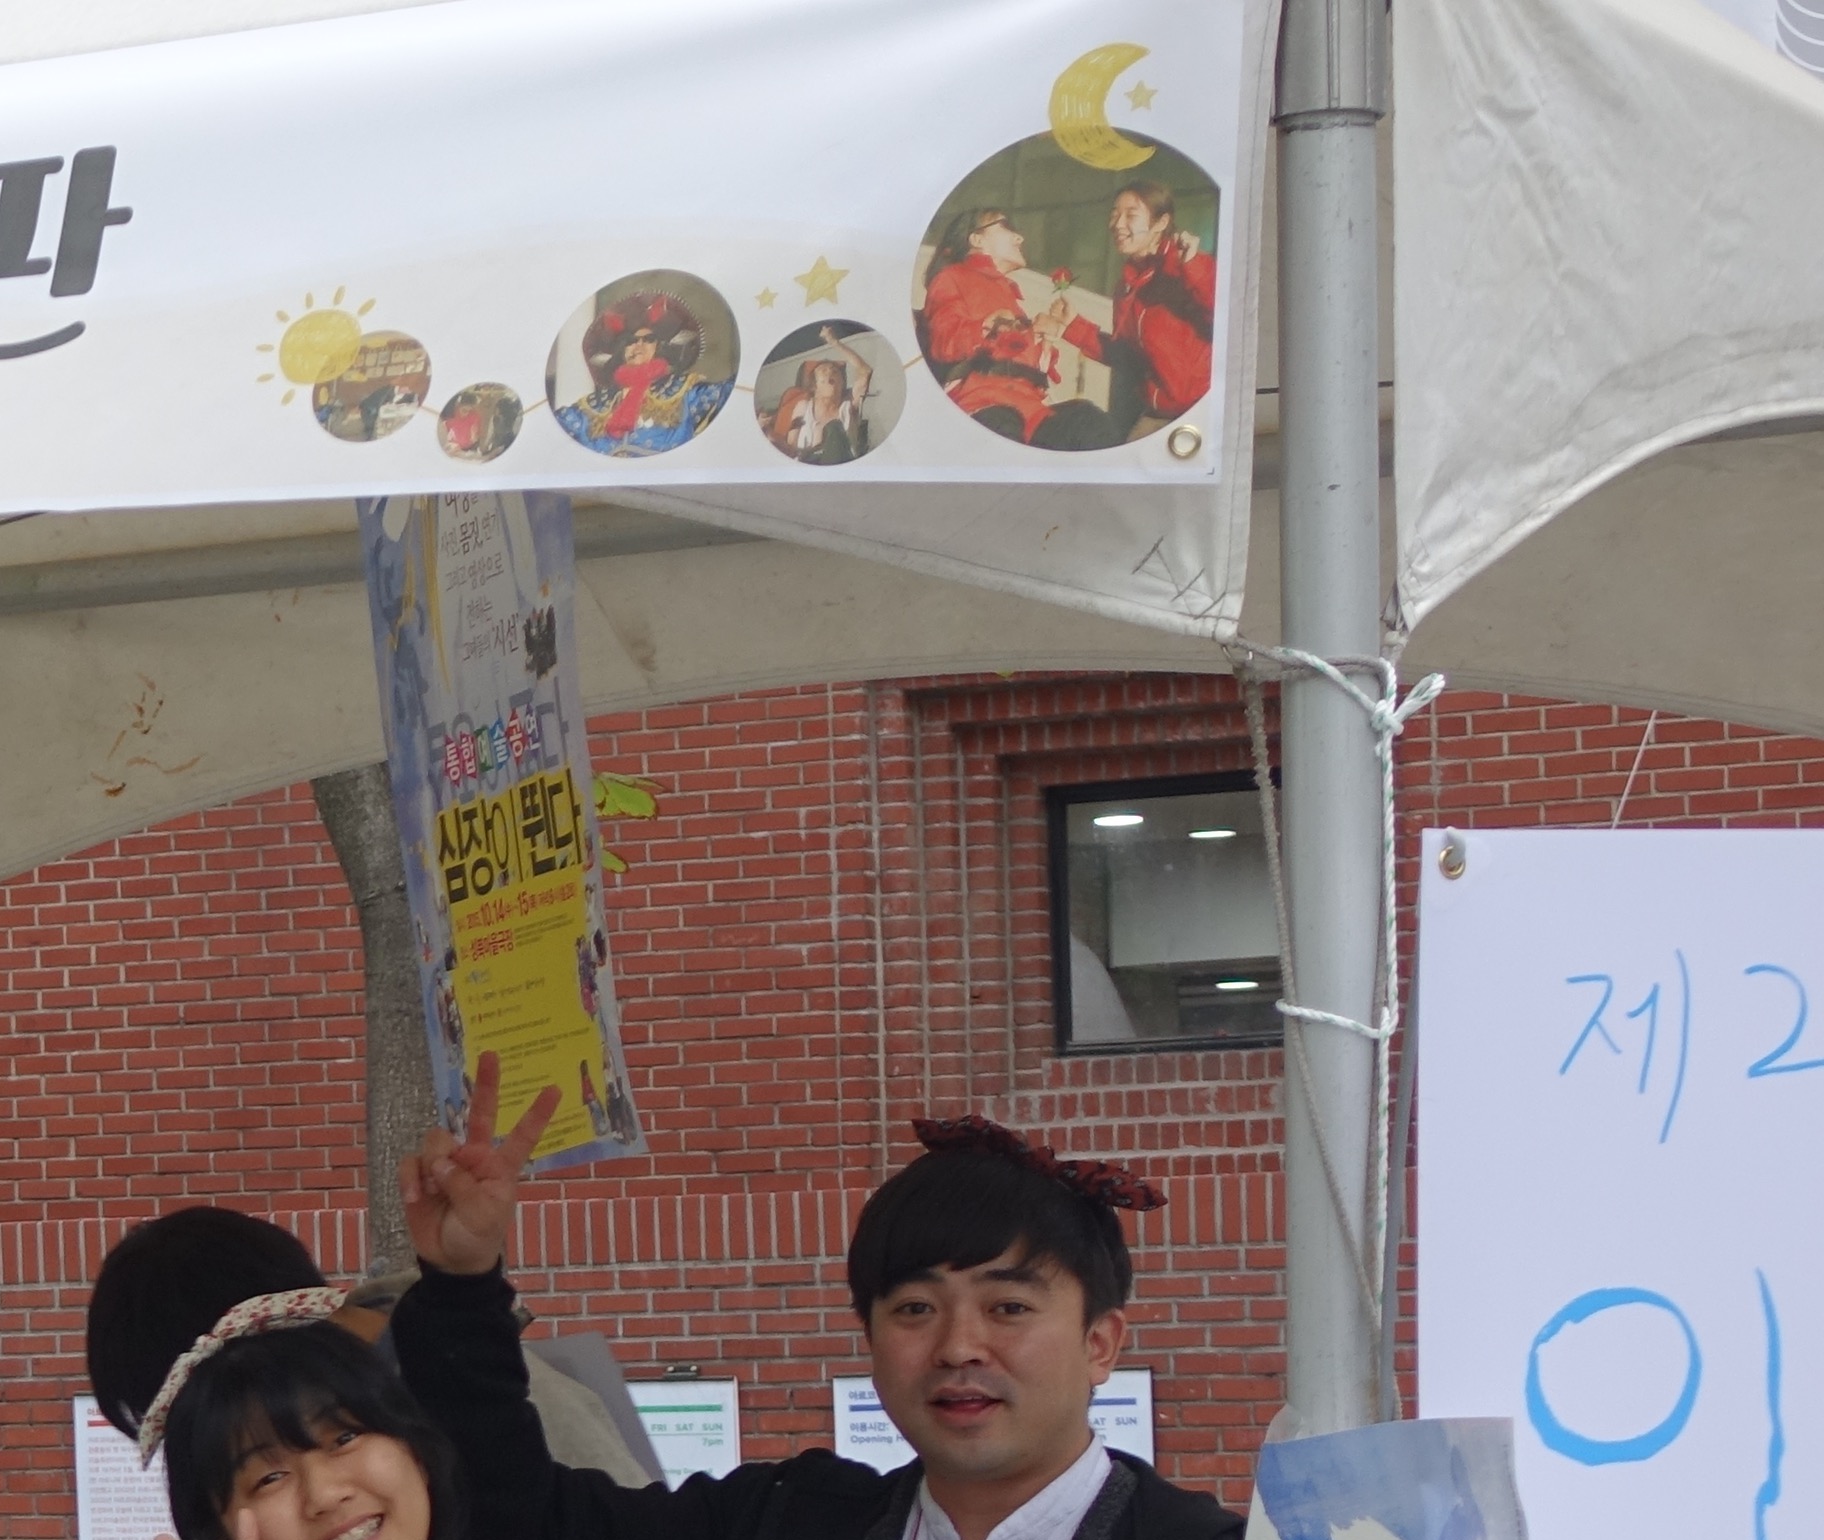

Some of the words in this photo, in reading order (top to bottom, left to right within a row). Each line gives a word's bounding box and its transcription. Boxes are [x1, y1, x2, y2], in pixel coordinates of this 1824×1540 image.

[438, 788, 523, 904] 심장이
[1115, 1417, 1137, 1426] SUN
[651, 1423, 667, 1432] FRI
[675, 1423, 693, 1431] SAT
[702, 1423, 723, 1431] SUN
